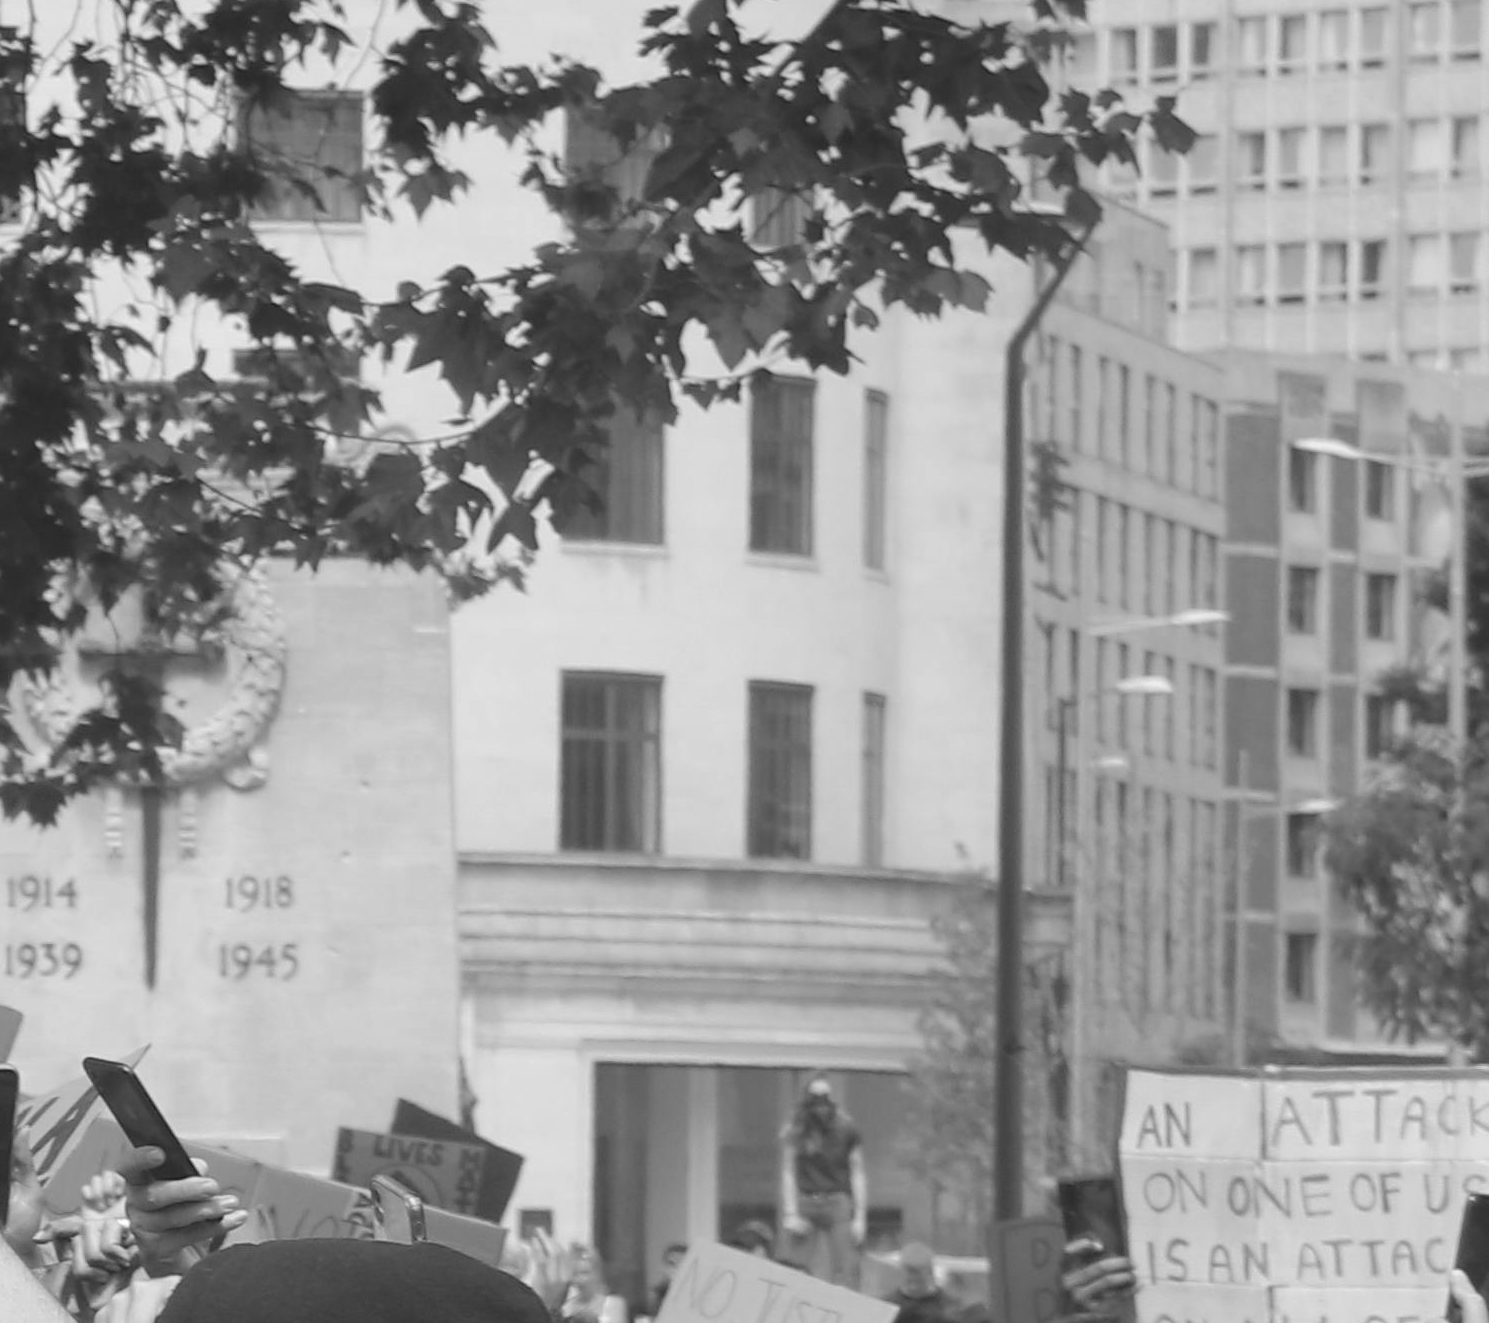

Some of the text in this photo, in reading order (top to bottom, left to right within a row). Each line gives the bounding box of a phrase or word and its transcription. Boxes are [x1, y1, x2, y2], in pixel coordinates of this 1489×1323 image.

[6, 875, 295, 910] 1914 1918
[4, 943, 299, 979] 1939 1945
[1136, 1089, 1489, 1149] AN ATTACK
[373, 1135, 444, 1166] LIVES
[1143, 1169, 1208, 1214] ON
[1228, 1175, 1332, 1219] ONE
[1350, 1172, 1402, 1213] OF
[1147, 1238, 1190, 1285] IS
[1209, 1242, 1270, 1284] AN
[673, 1256, 736, 1320] NO
